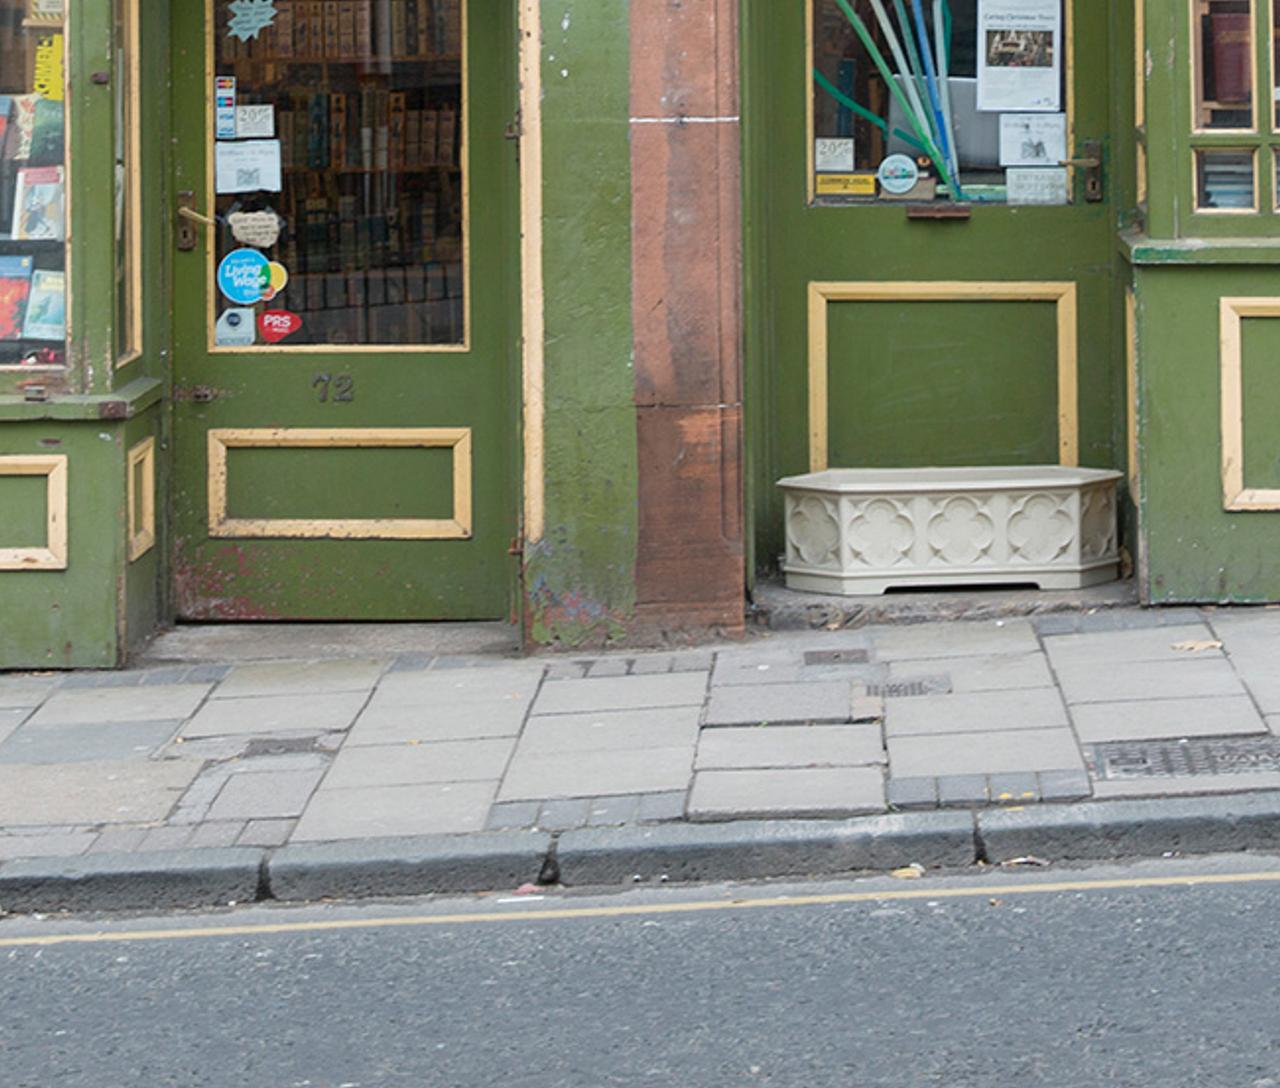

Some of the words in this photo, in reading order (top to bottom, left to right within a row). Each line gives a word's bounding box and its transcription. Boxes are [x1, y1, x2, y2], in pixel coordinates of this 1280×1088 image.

[225, 264, 261, 280] Living
[233, 273, 268, 289] Wage
[263, 313, 291, 328] PRS
[311, 370, 353, 403] 72
